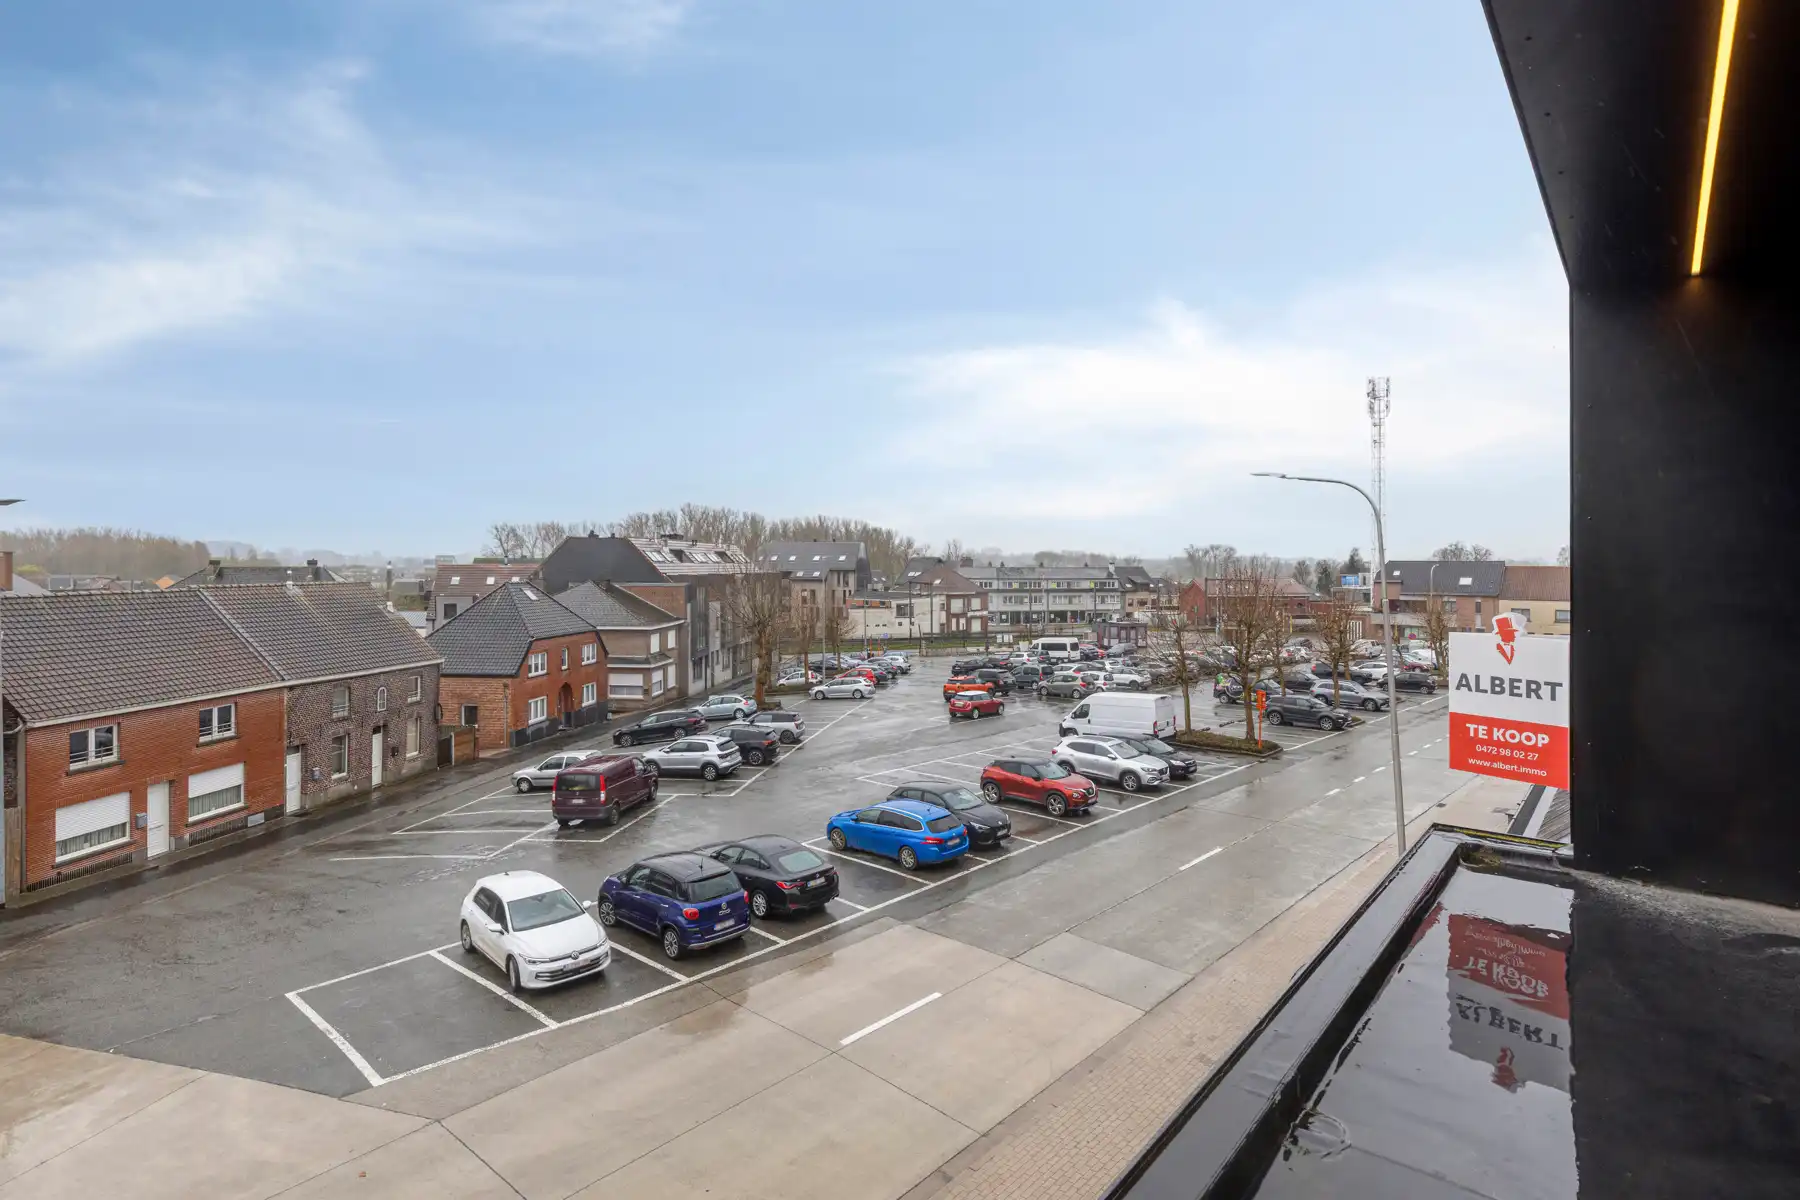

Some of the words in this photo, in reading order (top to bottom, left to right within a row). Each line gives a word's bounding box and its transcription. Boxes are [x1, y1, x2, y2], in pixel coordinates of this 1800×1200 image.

[1455, 672, 1563, 702] ALBERT
[1465, 723, 1488, 739] TE
[1492, 727, 1550, 747] KOOP
[1475, 744, 1498, 755] 0472
[1499, 748, 1511, 757] 98
[1513, 750, 1525, 759] 02
[1527, 752, 1539, 761] 27
[1468, 757, 1547, 777] www.albert.immo
